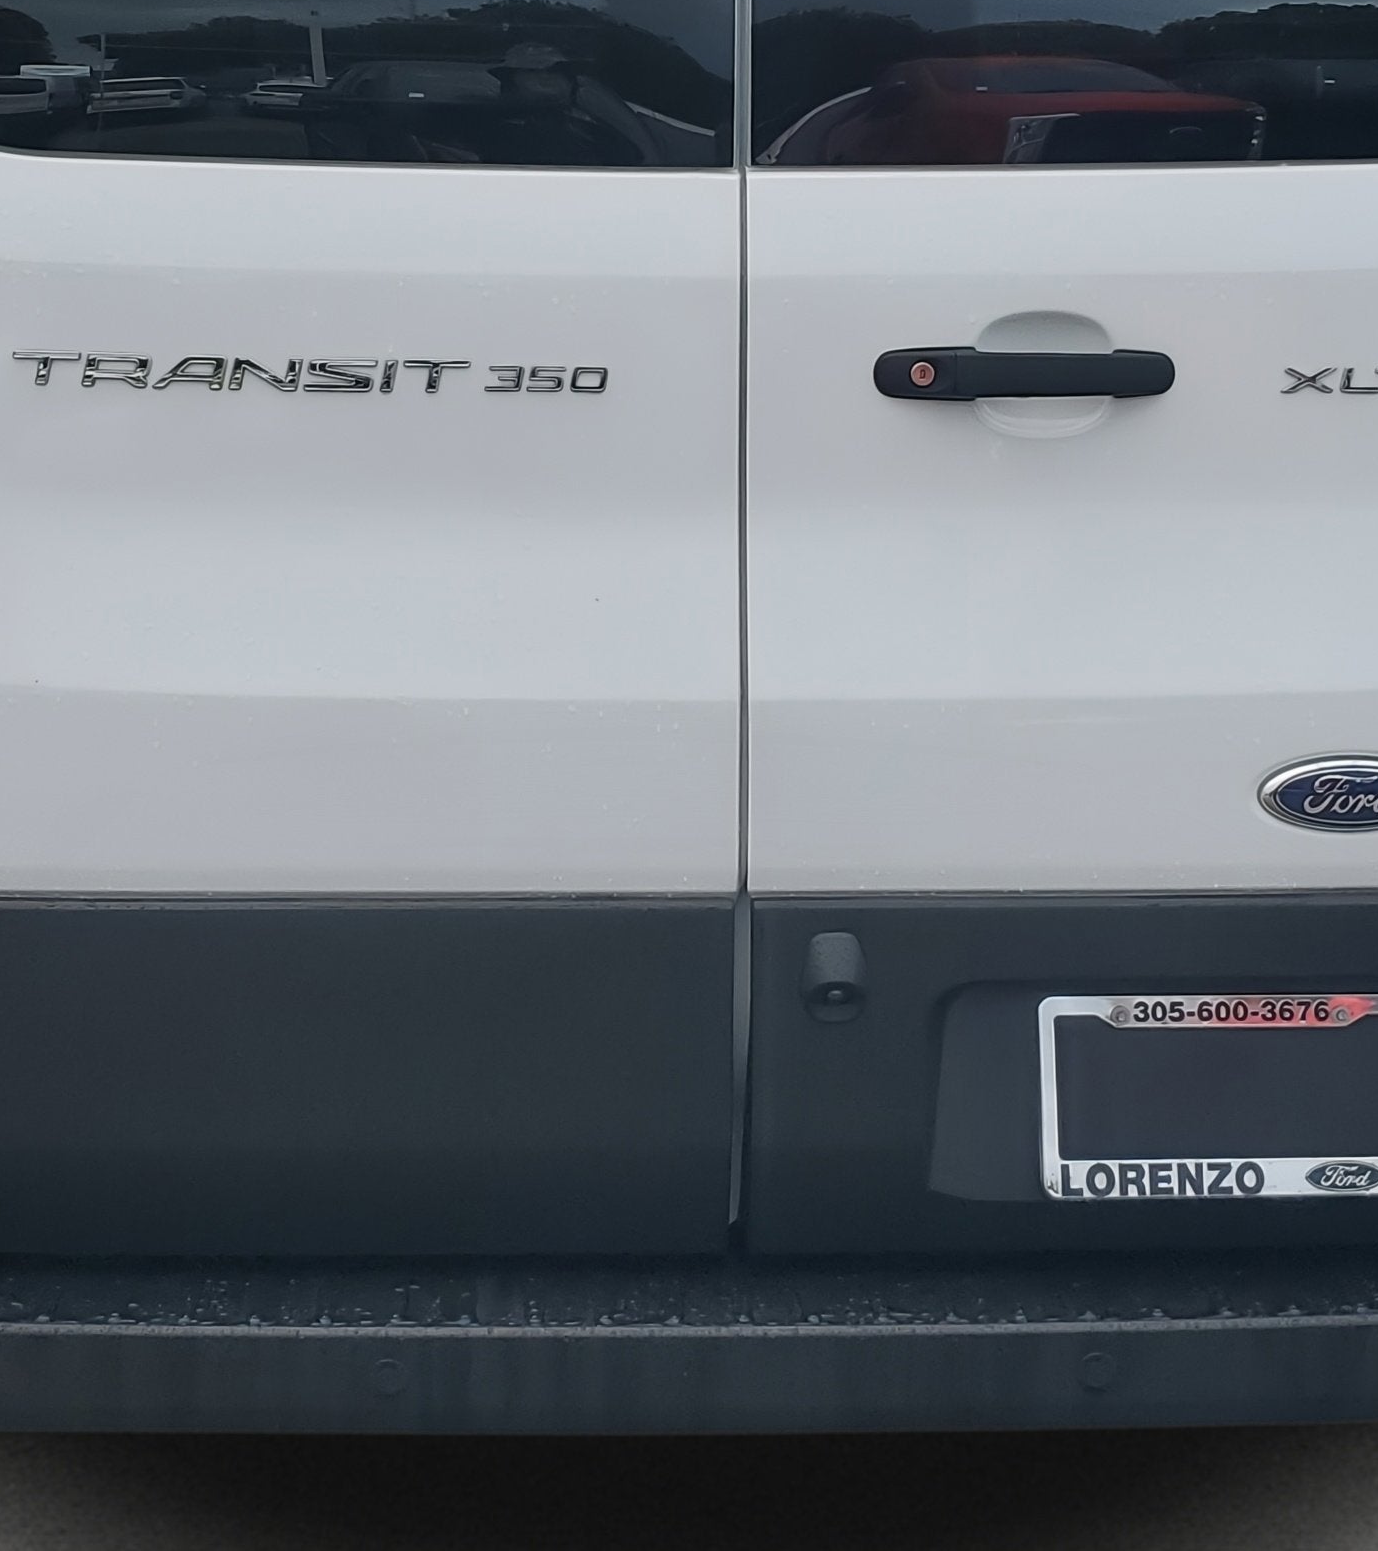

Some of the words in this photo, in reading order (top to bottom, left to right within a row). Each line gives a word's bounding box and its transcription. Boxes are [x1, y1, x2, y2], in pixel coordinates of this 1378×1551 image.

[12, 349, 472, 393] TRANSIT
[483, 364, 609, 394] 350
[1132, 1000, 1330, 1024] 305-600-3676
[1059, 1160, 1266, 1197] LORENZO
[1320, 1164, 1372, 1188] Ford
